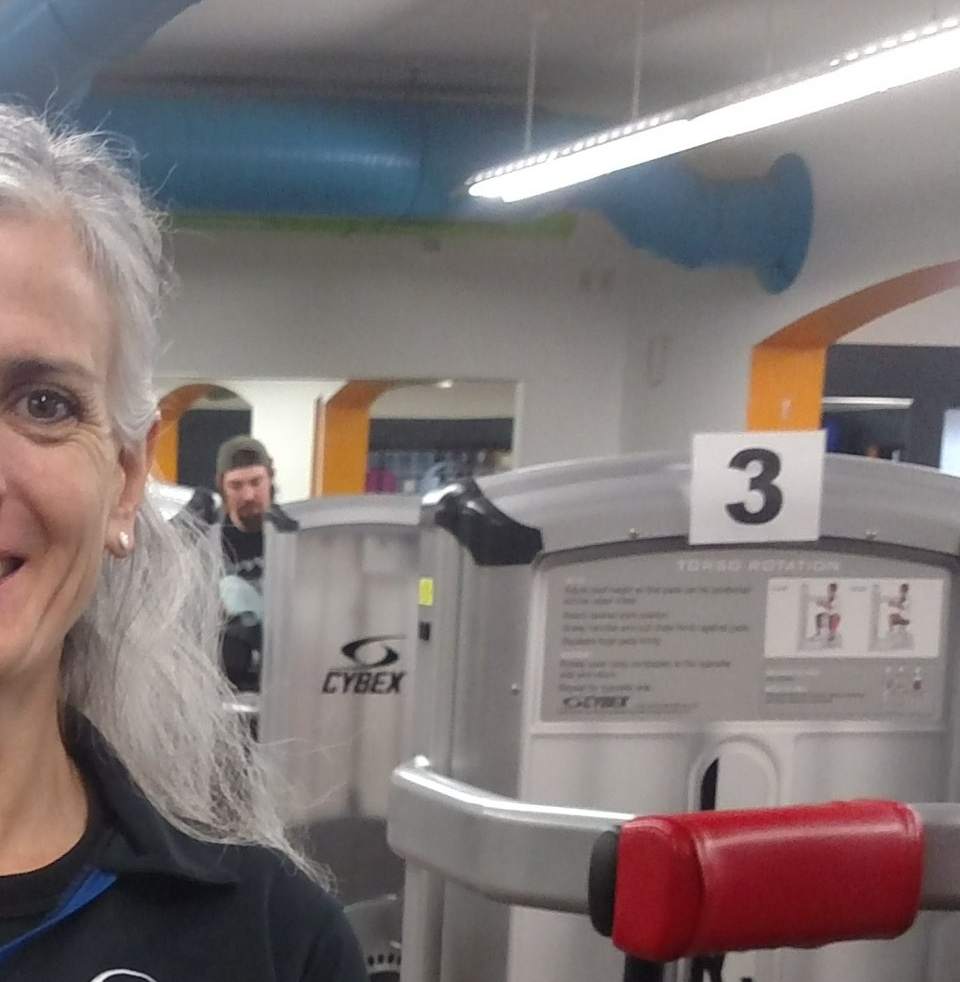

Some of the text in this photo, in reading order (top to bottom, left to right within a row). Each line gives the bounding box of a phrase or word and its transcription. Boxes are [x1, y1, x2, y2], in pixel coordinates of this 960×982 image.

[725, 448, 784, 526] 3
[748, 559, 841, 572] ROTATION
[322, 670, 406, 695] CYBEX
